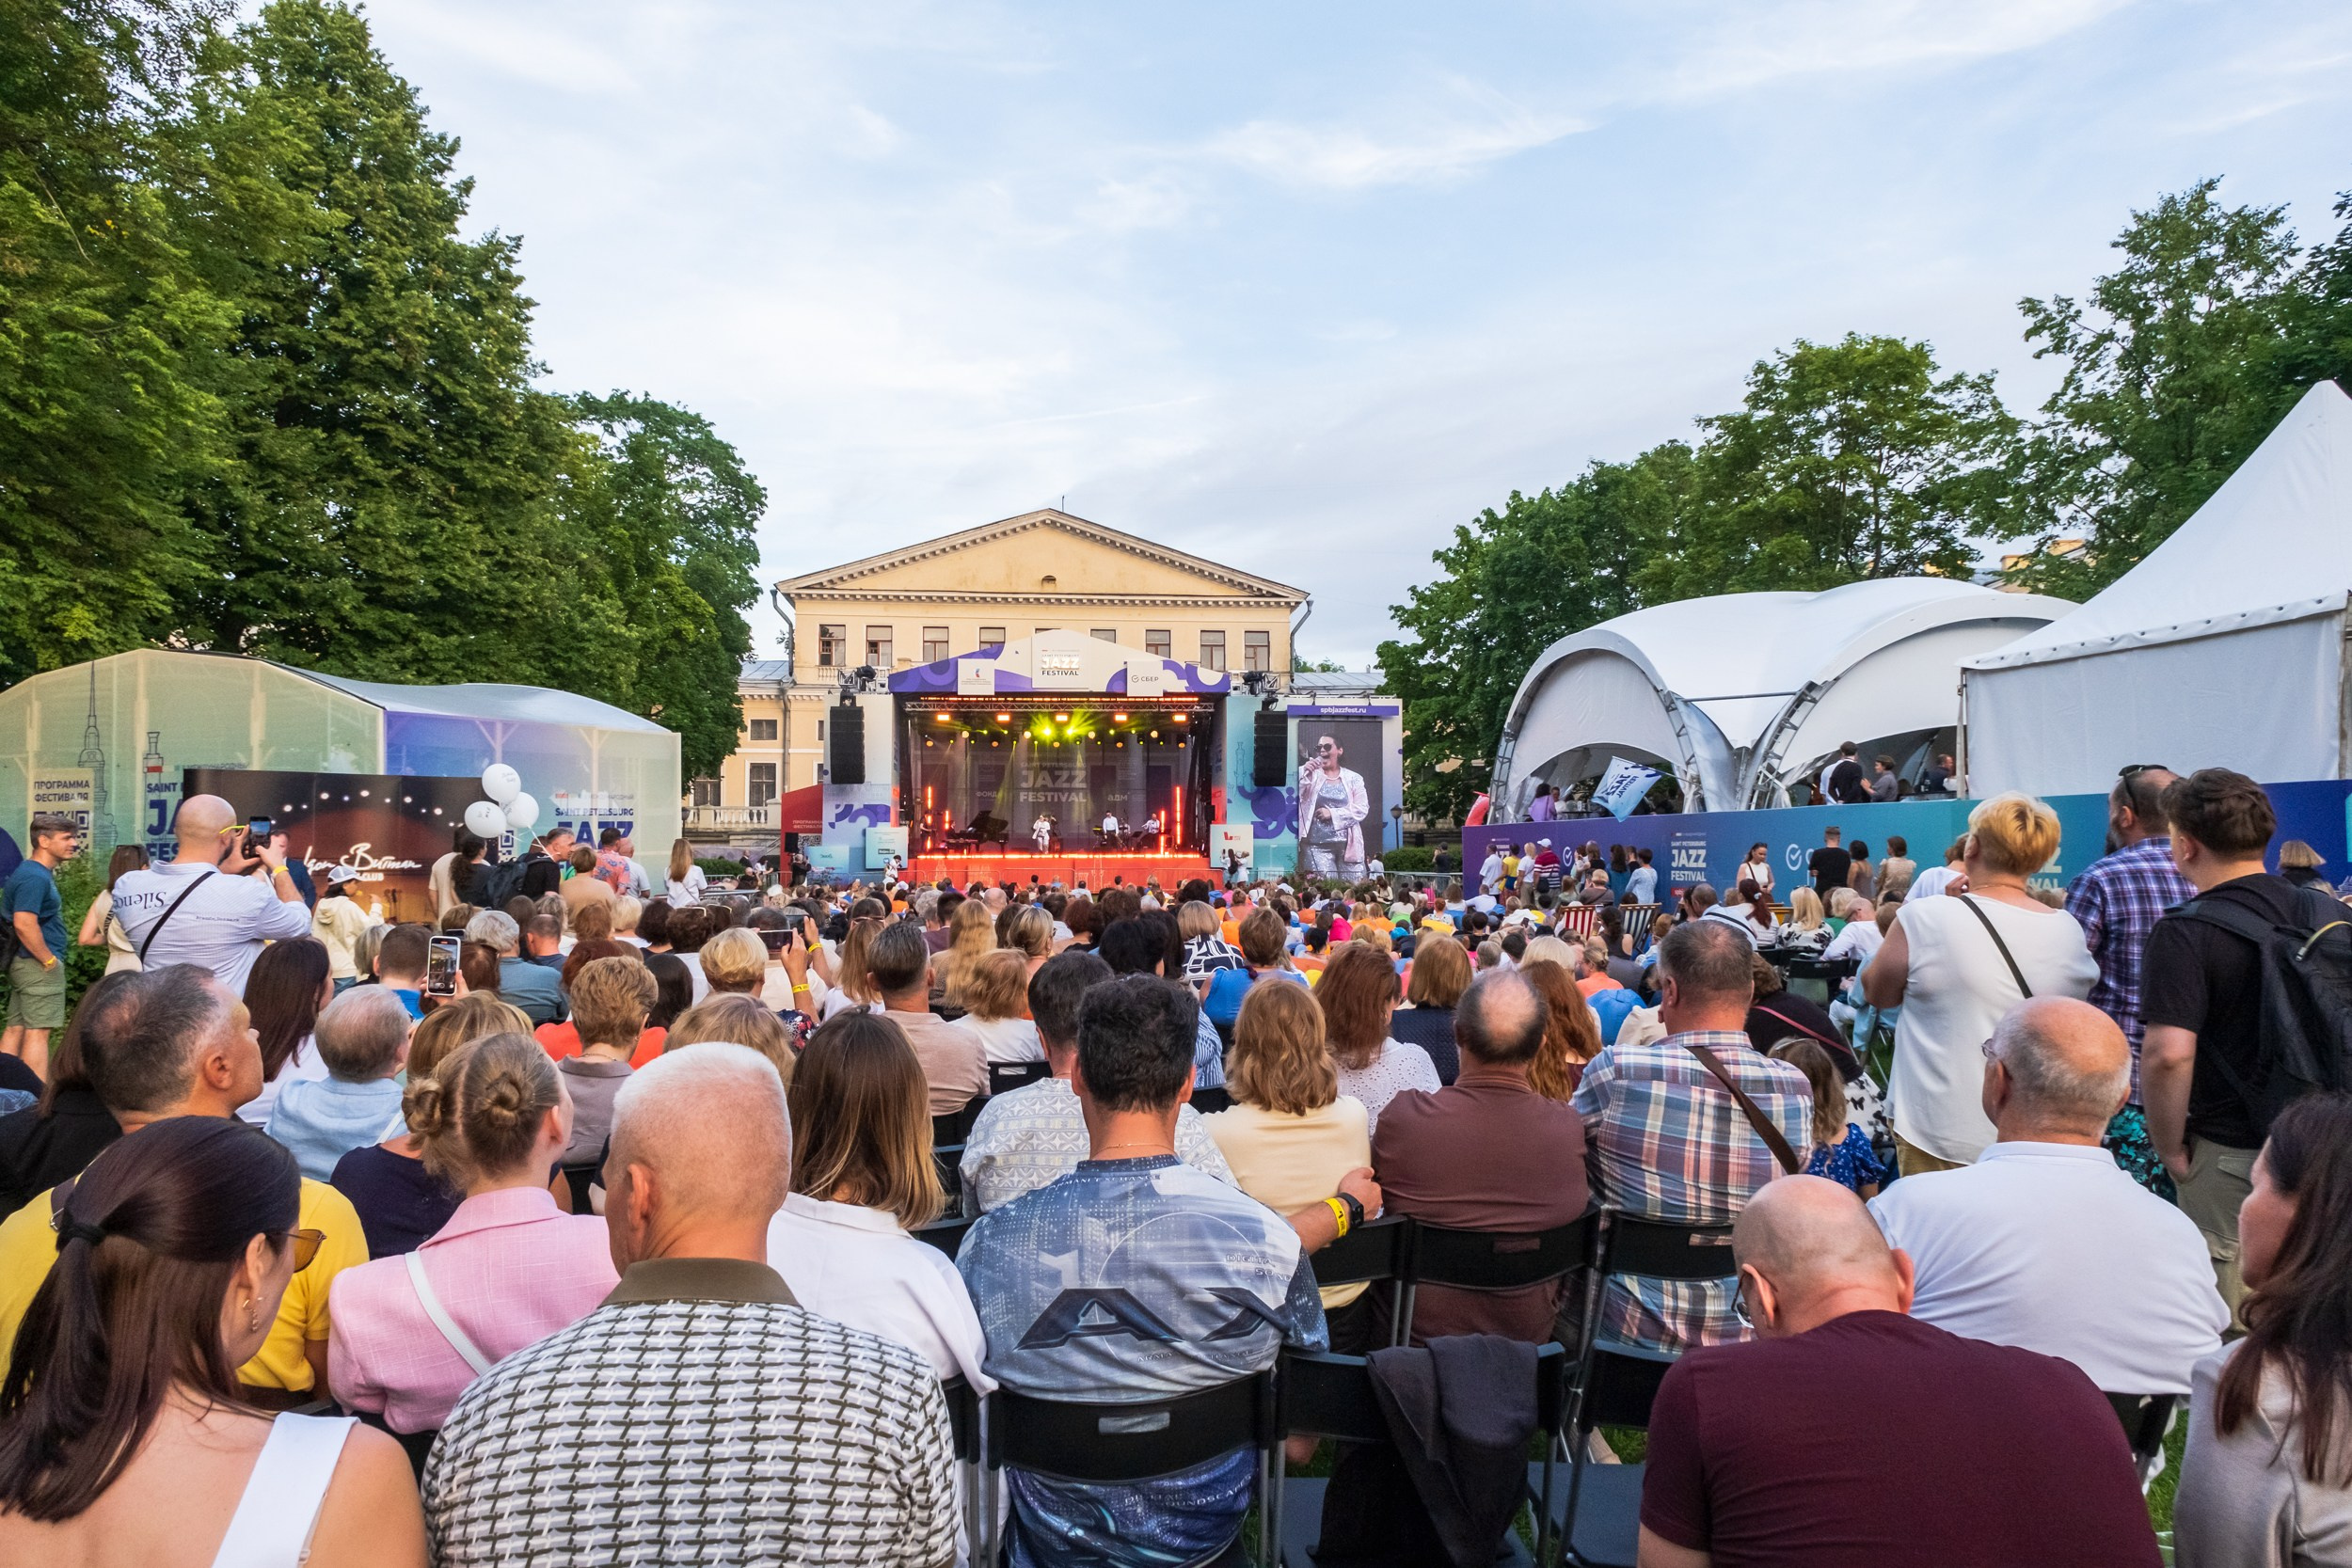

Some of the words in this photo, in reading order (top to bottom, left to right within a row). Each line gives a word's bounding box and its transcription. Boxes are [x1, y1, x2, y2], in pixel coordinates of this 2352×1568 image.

[1041, 657, 1080, 669] JAZZ
[1320, 706, 1367, 715] spbjazzfest.ru
[1020, 770, 1088, 788] JAZZ
[34, 780, 90, 789] ПРОГРАММА
[147, 783, 178, 793] SAINT
[1020, 792, 1087, 802] FESTIVAL
[1671, 848, 1707, 868] JAZZ
[1670, 870, 1707, 881] FESTIVAL
